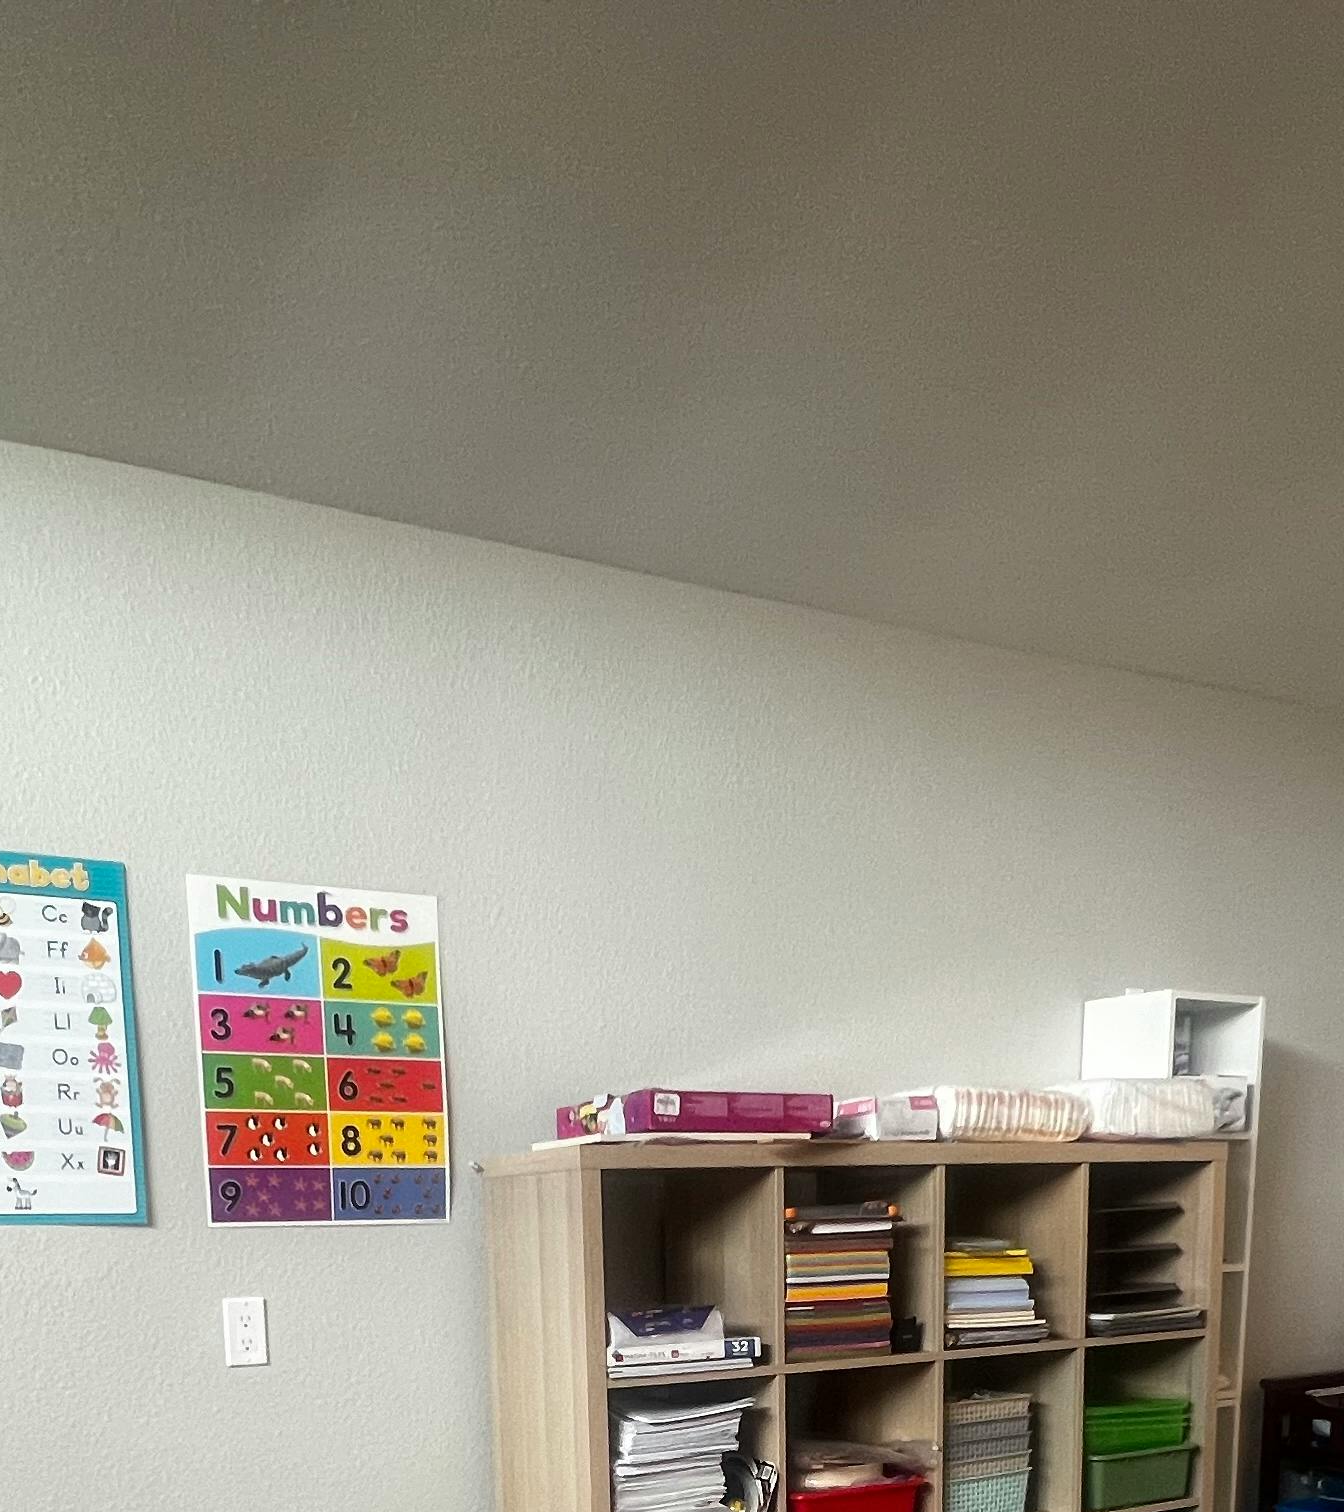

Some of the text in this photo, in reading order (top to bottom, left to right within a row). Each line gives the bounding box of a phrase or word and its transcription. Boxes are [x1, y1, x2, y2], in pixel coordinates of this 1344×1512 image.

[42, 905, 67, 923] Cc
[216, 884, 409, 933] Numbers
[47, 941, 68, 958] Ff
[214, 950, 222, 983] 1
[332, 958, 352, 989] 2
[55, 977, 65, 994] Ii
[55, 1013, 70, 1030] Ll
[211, 1009, 231, 1040] 3
[334, 1014, 355, 1045] 4
[52, 1049, 79, 1065] Oo
[58, 1084, 80, 1100] Rr
[214, 1066, 235, 1099] 5
[338, 1069, 358, 1102] 6
[58, 1118, 83, 1135] Uu
[217, 1125, 237, 1156] 7
[342, 1126, 361, 1156] 8
[62, 1153, 84, 1170] Xx
[219, 1180, 242, 1212] 9
[339, 1179, 371, 1211] 10
[731, 1340, 749, 1353] 32
